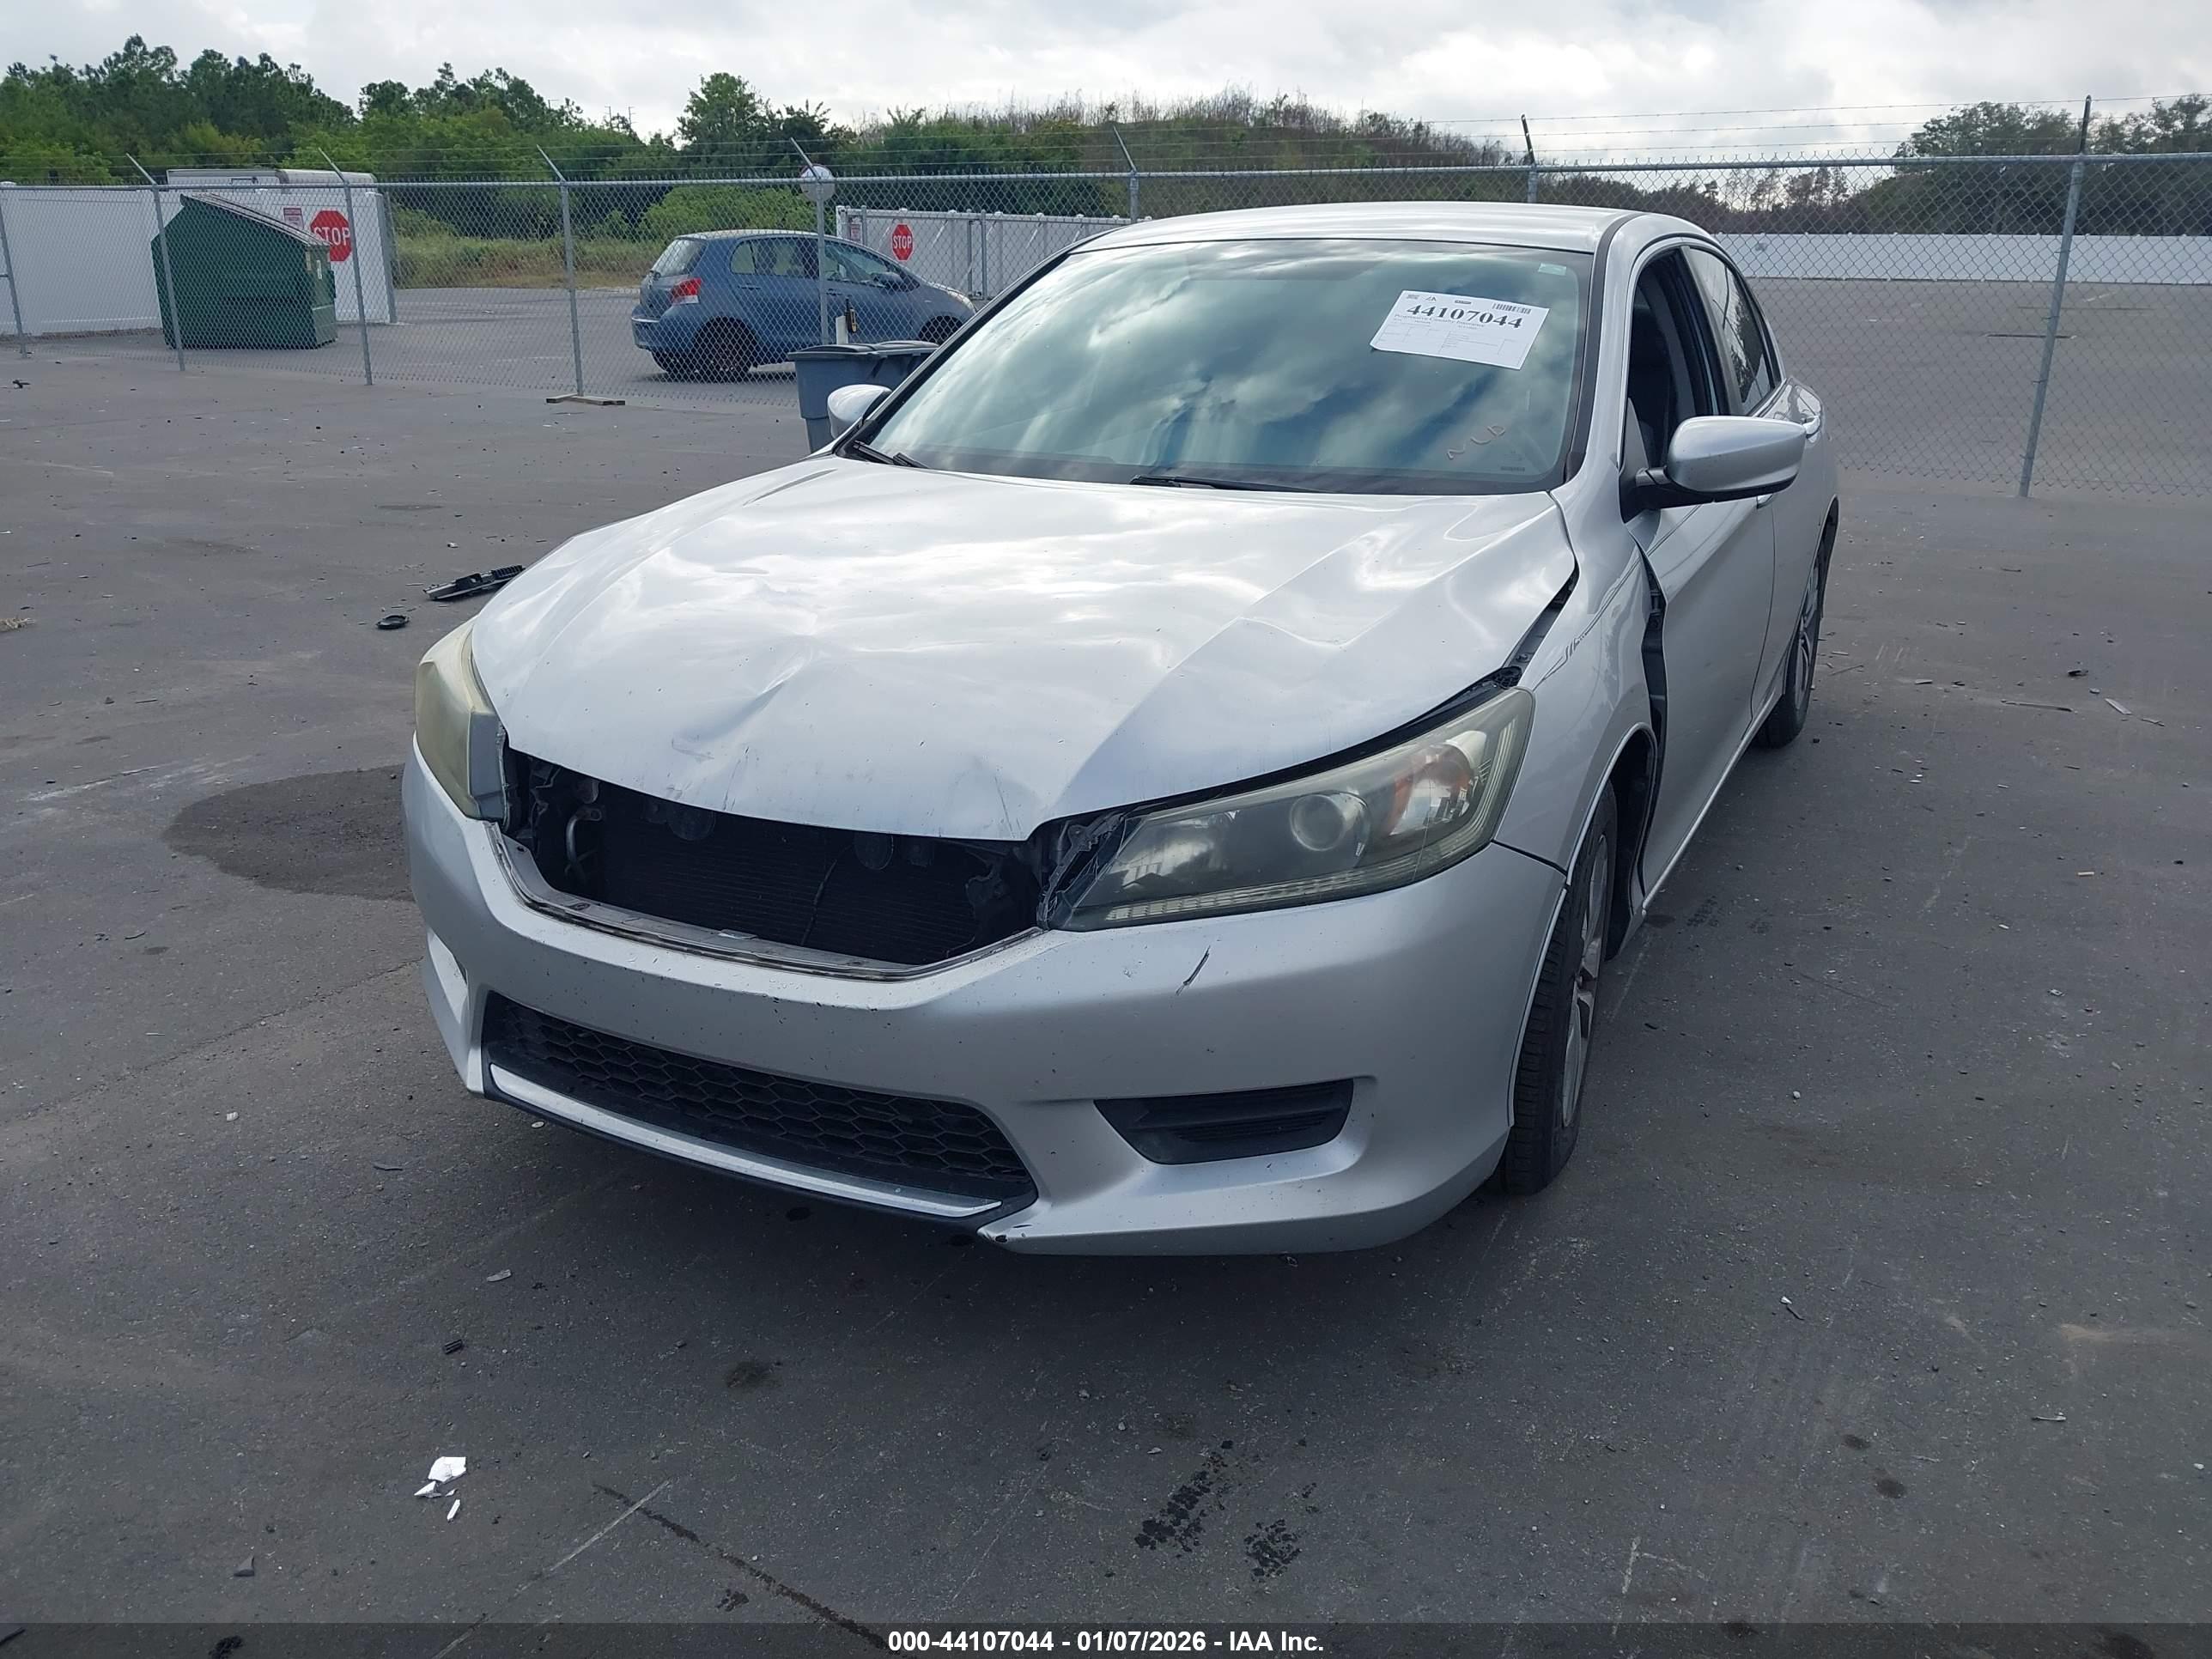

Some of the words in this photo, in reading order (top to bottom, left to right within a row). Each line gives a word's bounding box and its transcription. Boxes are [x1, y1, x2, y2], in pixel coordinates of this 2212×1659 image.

[313, 226, 350, 246] STOP
[893, 235, 913, 249] STOP
[1407, 304, 1523, 329] 44107044
